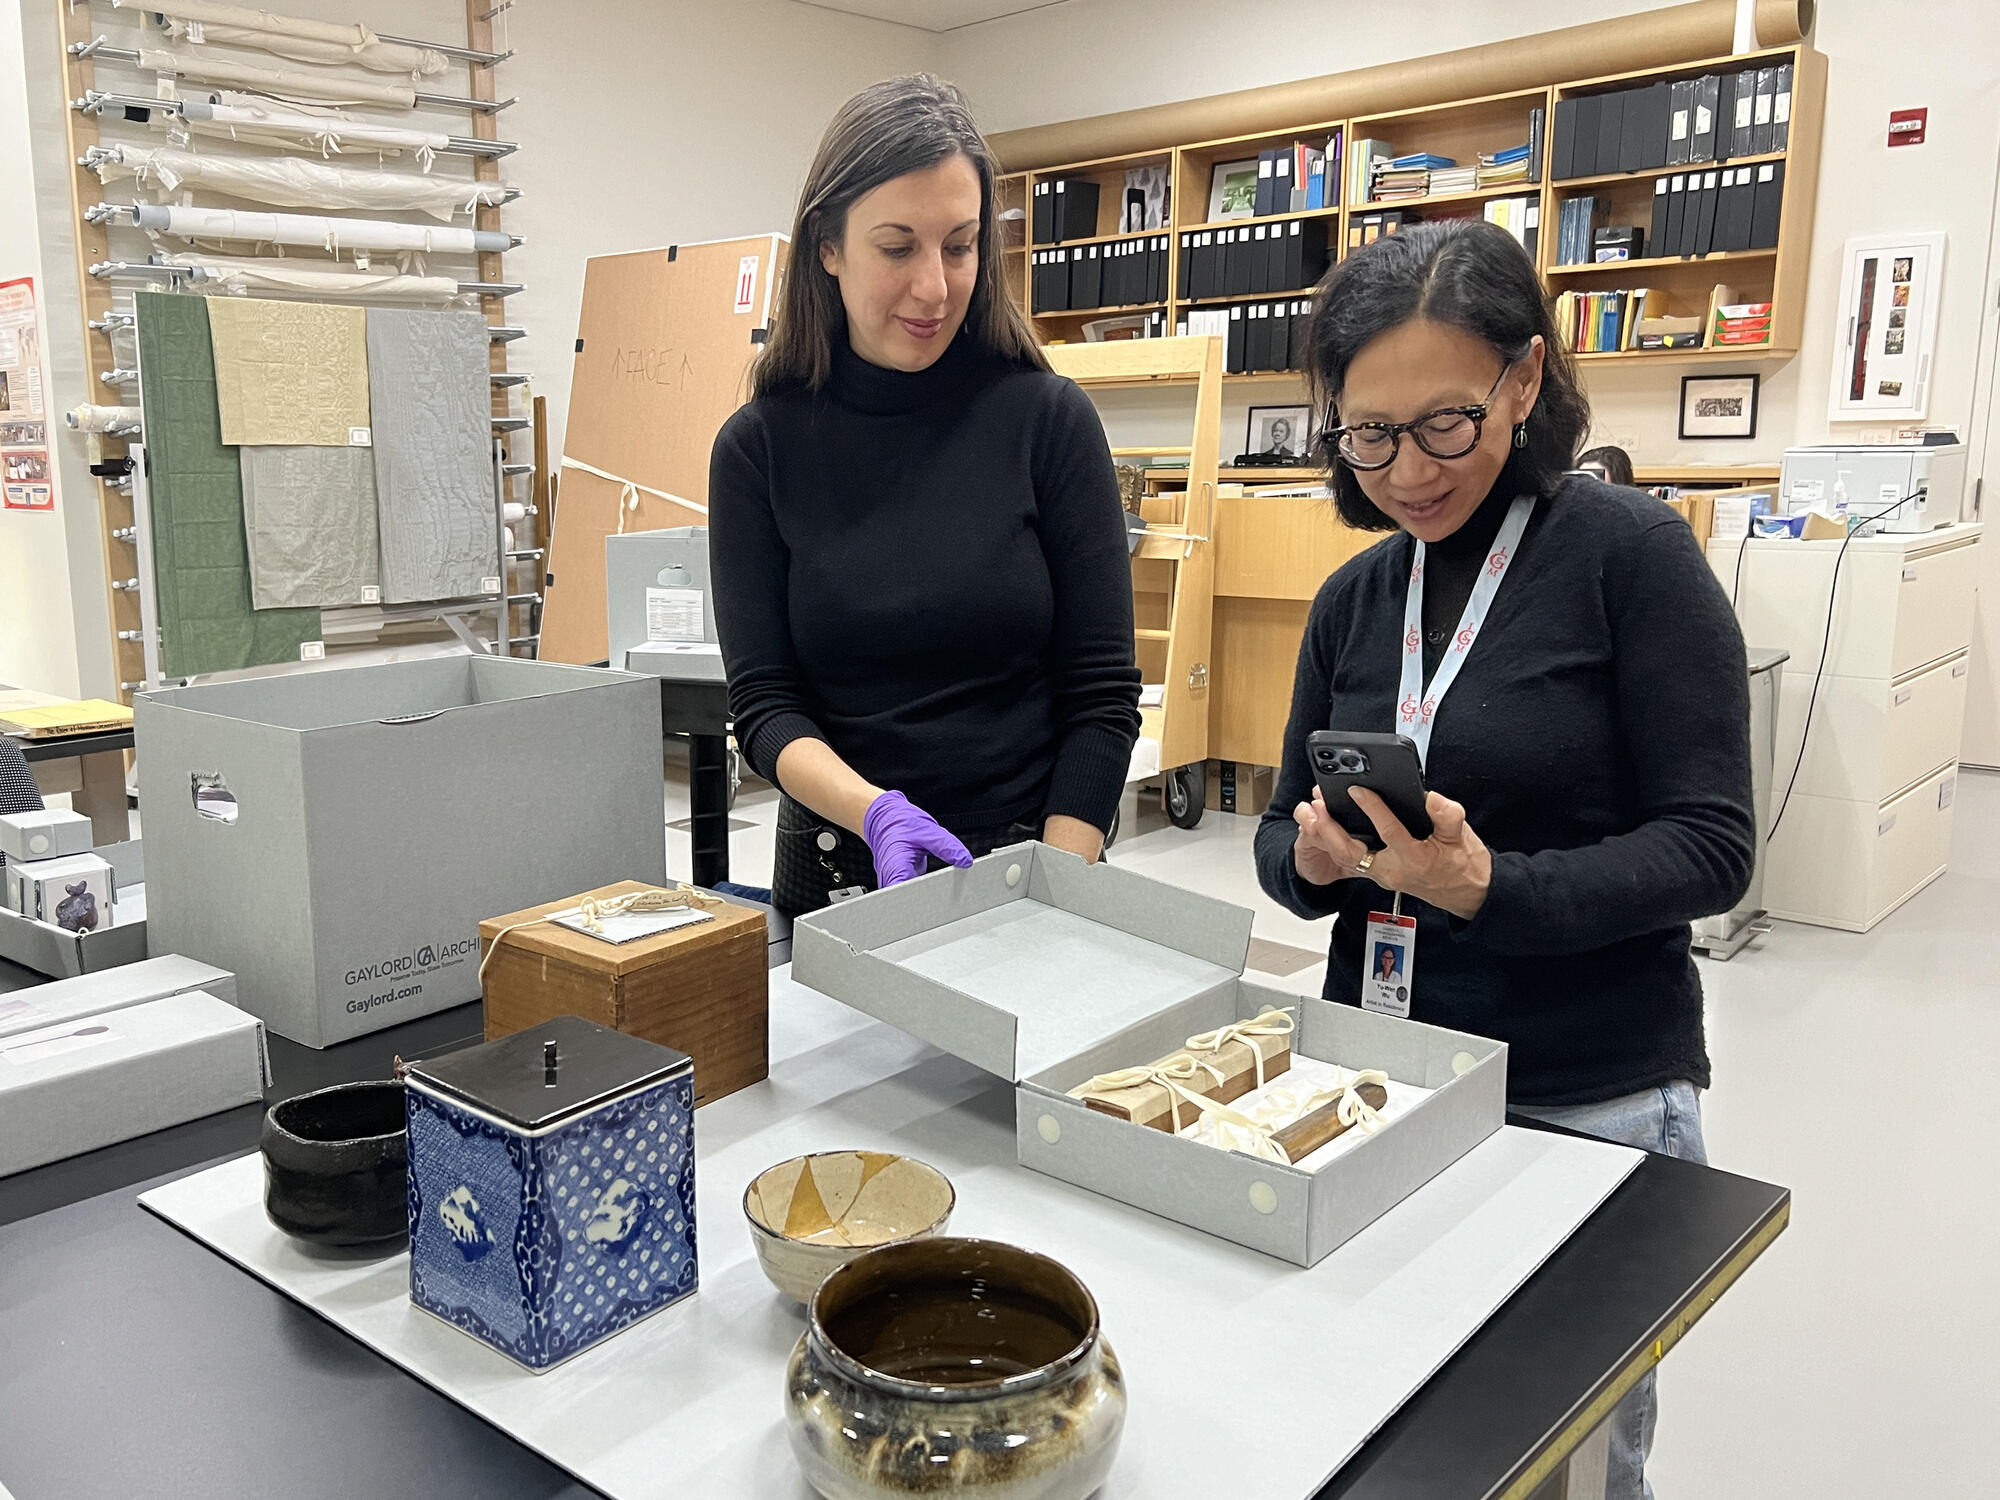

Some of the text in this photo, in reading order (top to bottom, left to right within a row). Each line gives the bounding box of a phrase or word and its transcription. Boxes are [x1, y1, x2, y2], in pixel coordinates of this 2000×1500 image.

[625, 348, 673, 385] FACE
[344, 956, 413, 985] GAYLORD
[440, 937, 480, 960] ARCHI
[346, 984, 422, 1014] Gaylord.com
